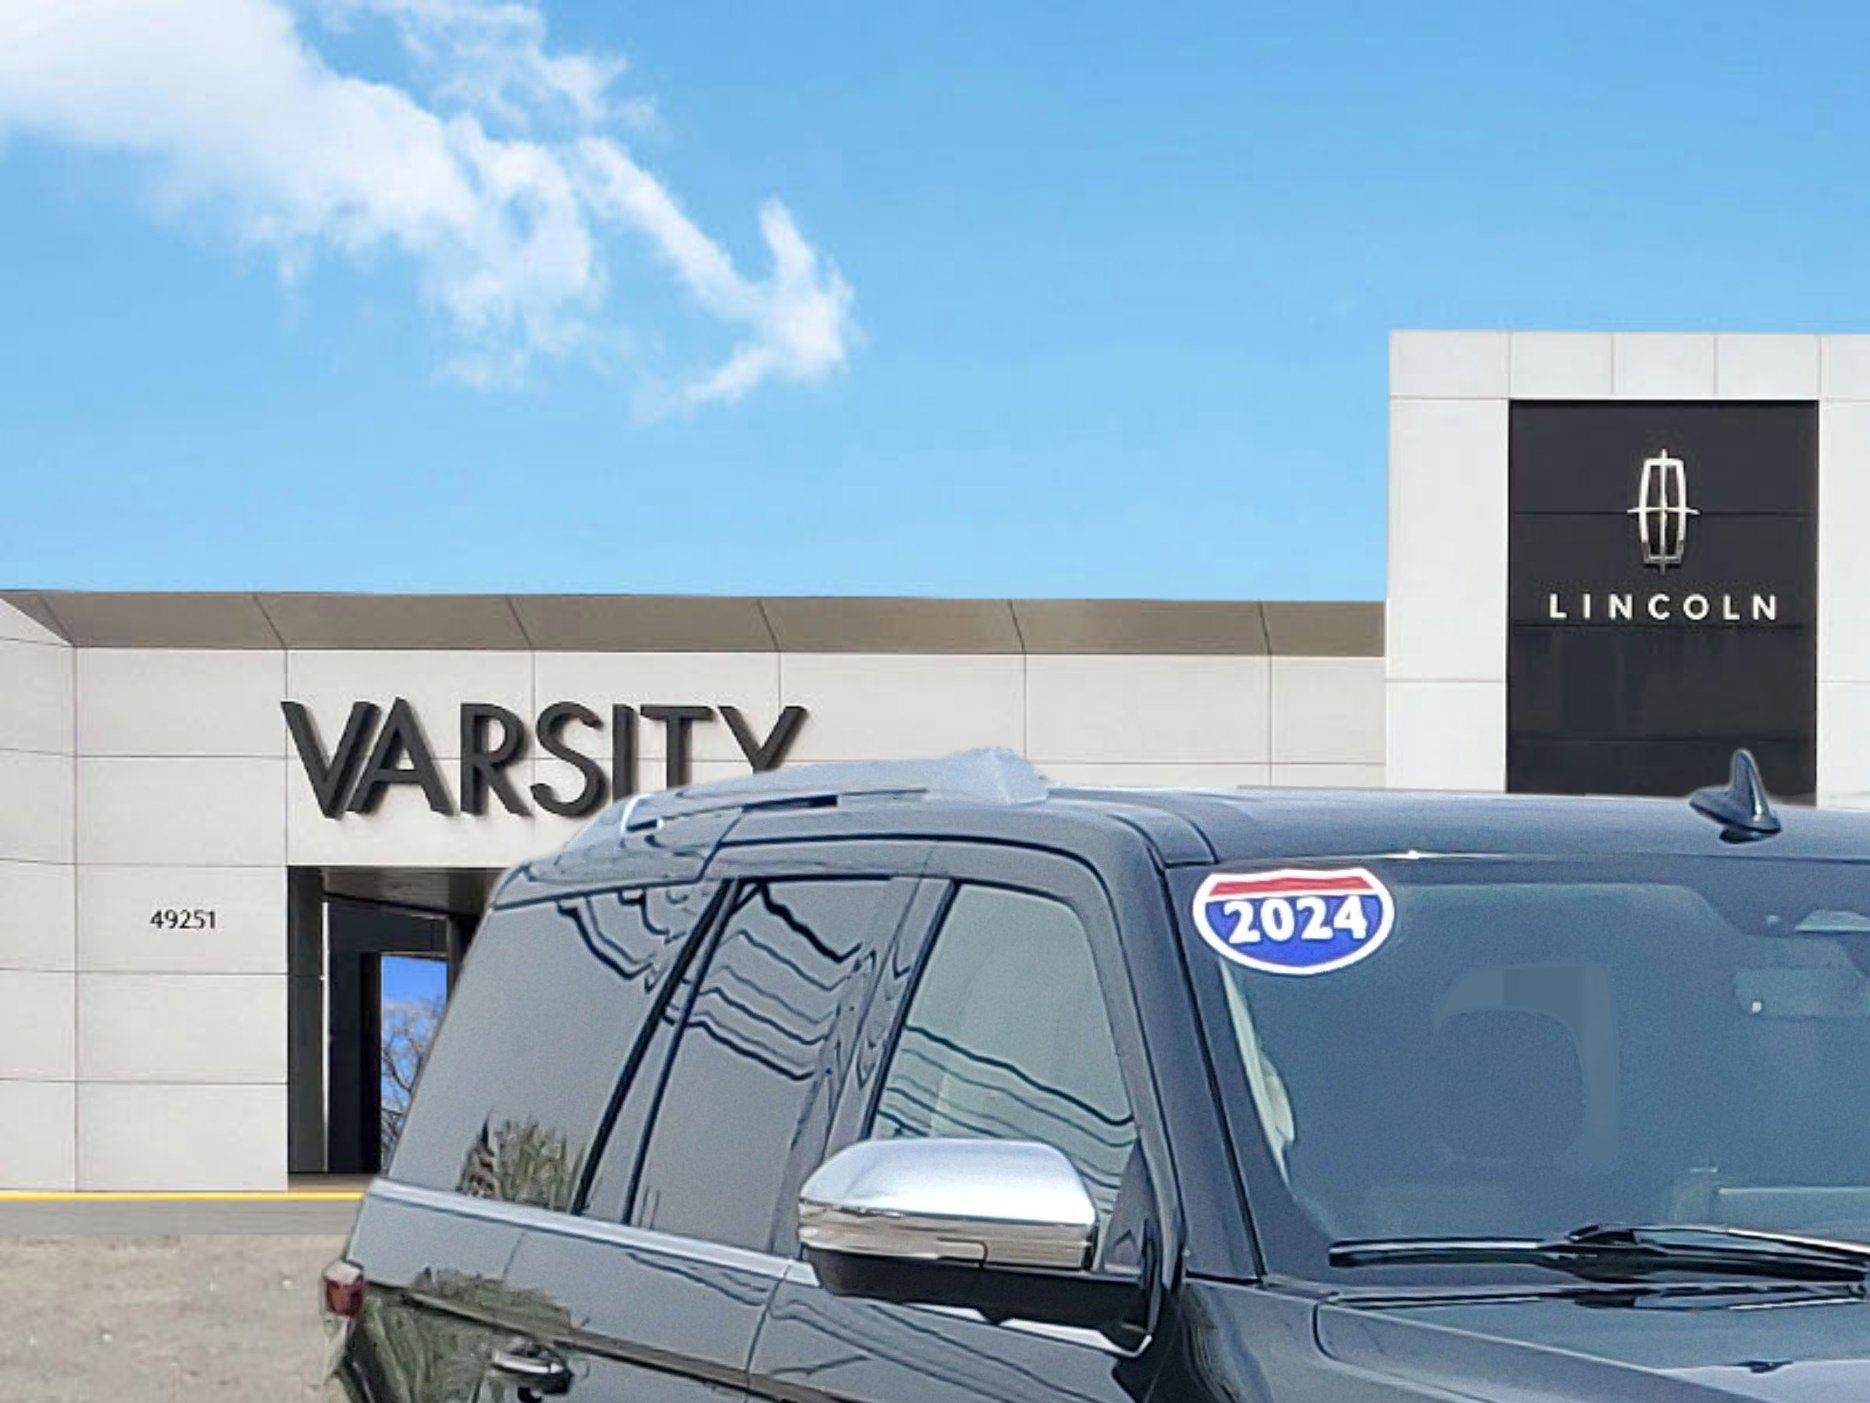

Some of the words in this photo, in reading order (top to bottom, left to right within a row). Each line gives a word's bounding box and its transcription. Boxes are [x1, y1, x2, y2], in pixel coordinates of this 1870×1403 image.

[1549, 593, 1777, 621] LINCOLN
[280, 696, 808, 820] VARSITY
[150, 909, 216, 929] 49251
[1223, 895, 1367, 944] 2024
